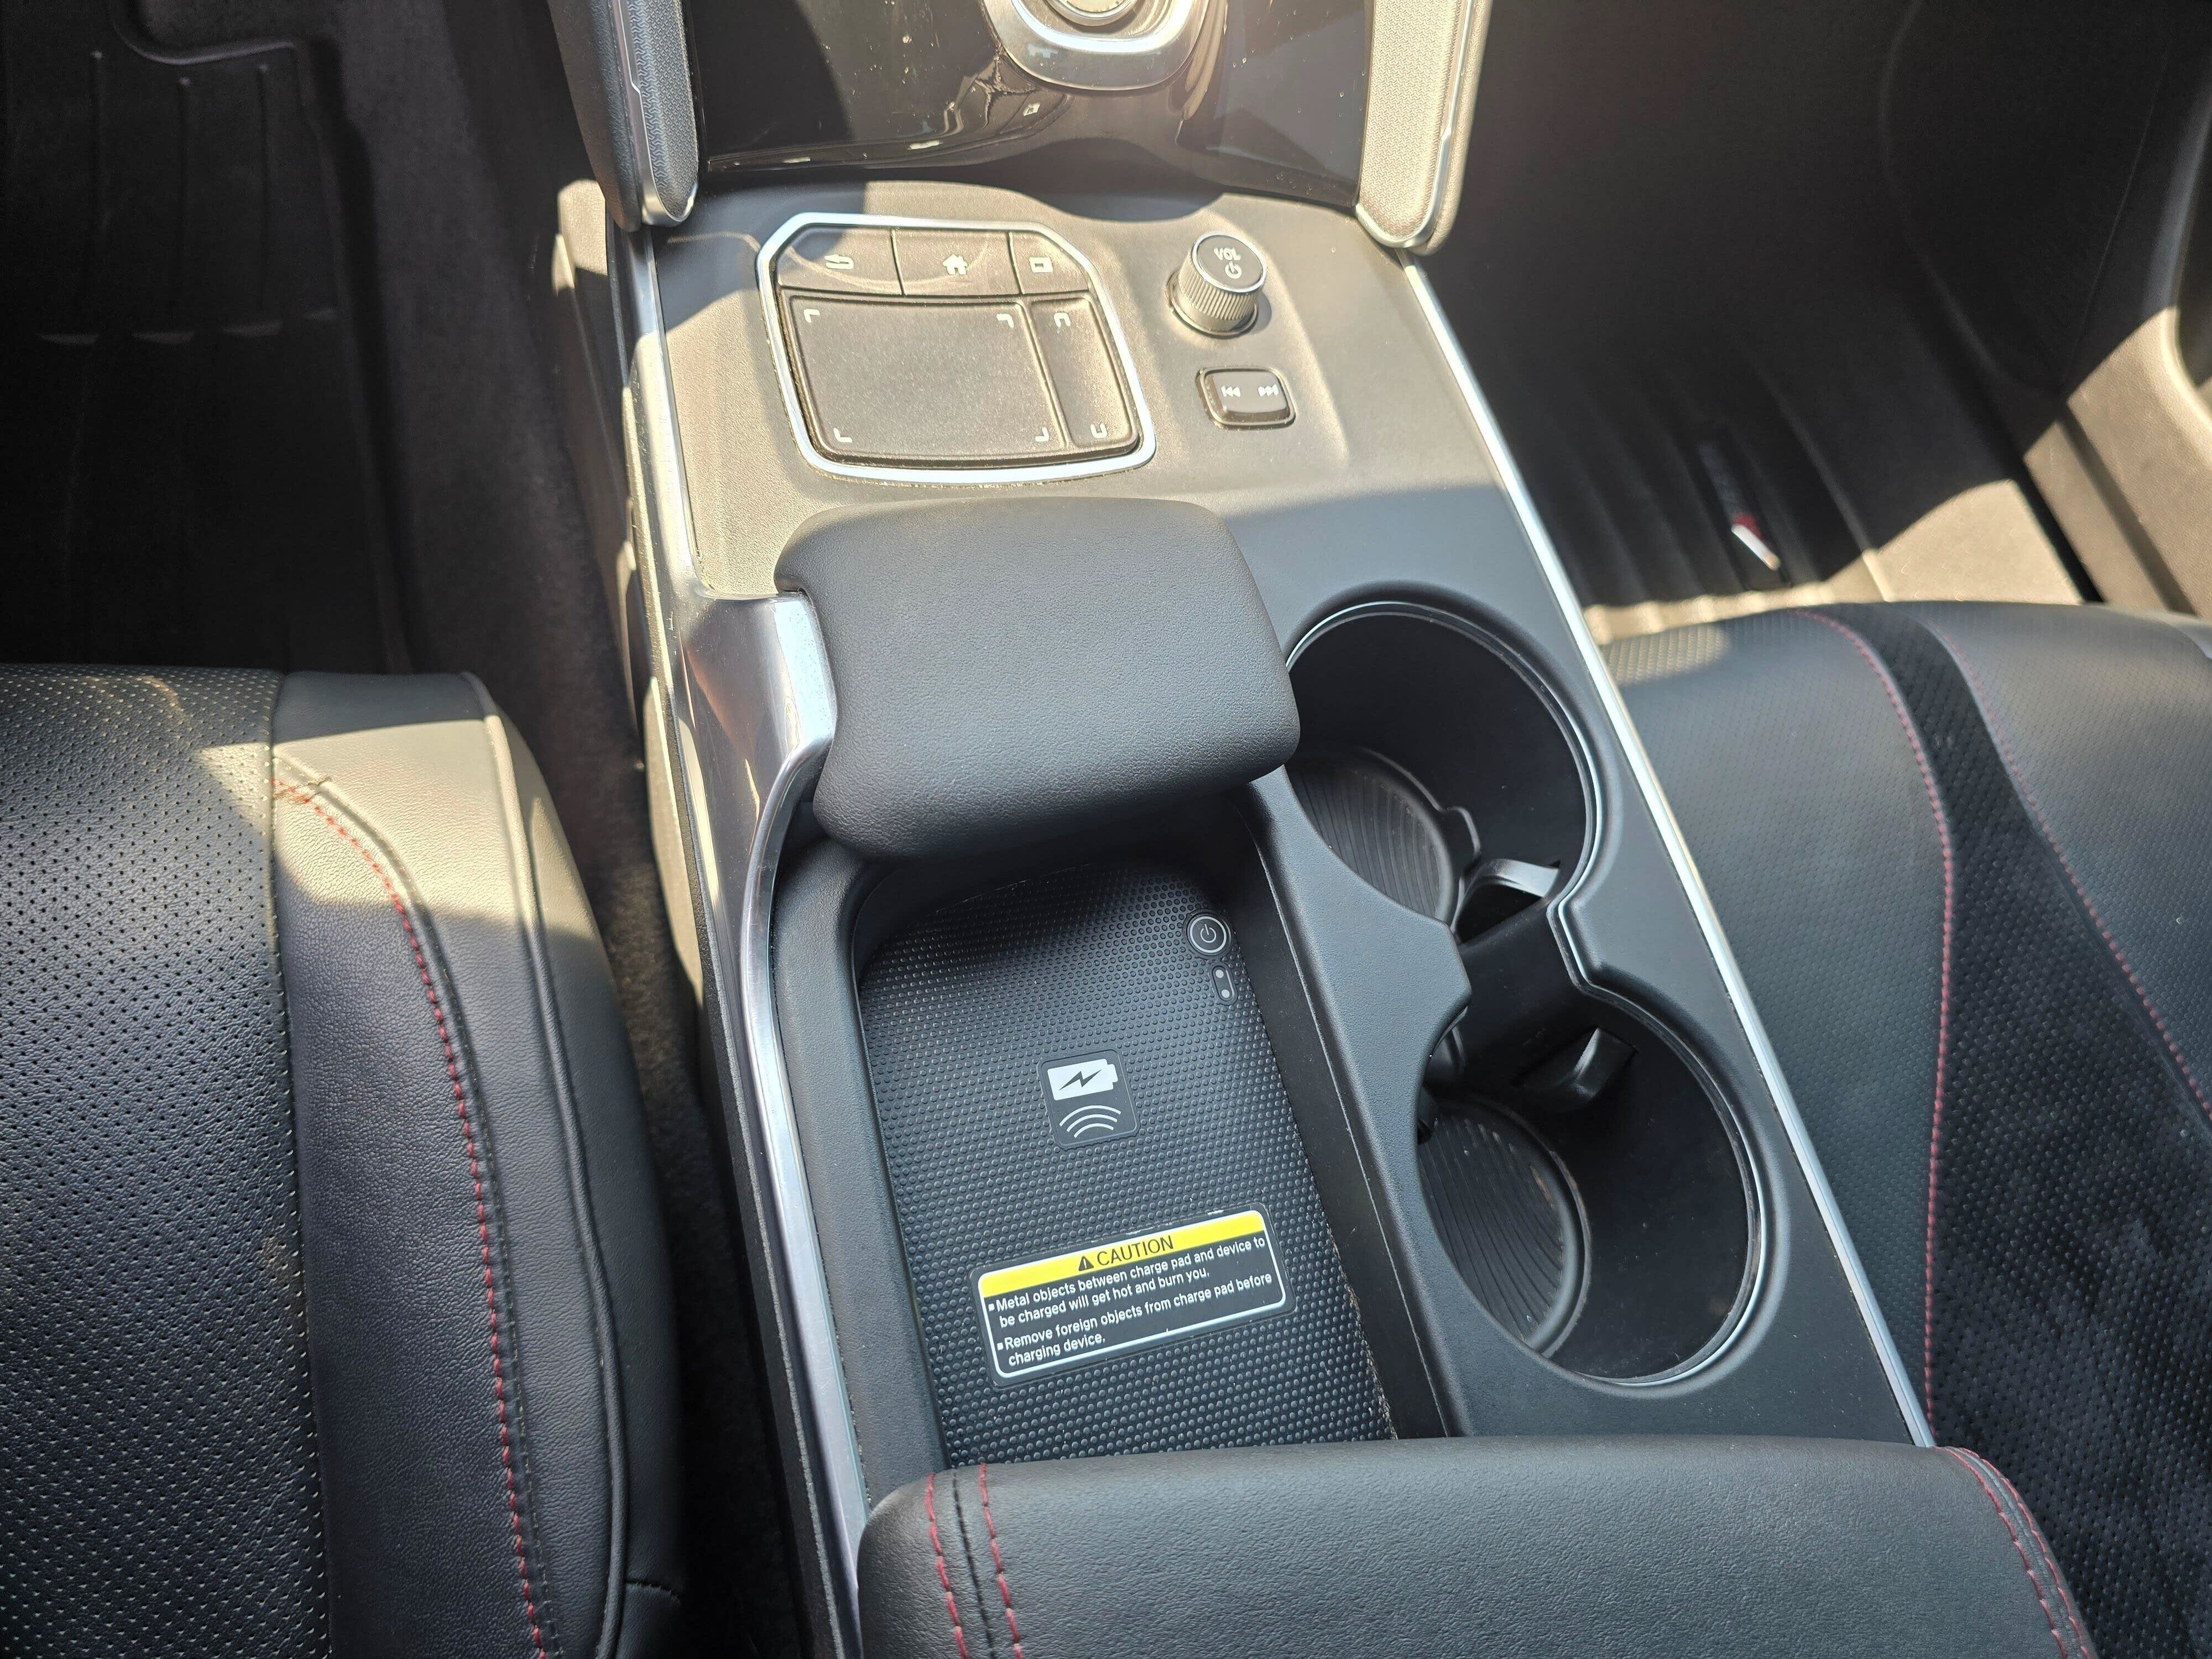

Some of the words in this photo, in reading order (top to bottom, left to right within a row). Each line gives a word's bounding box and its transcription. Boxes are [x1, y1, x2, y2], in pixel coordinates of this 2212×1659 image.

[1213, 247, 1241, 260] VOL
[1097, 1235, 1173, 1266] CAUTION
[996, 1292, 1030, 1312] Metal
[1033, 1282, 1076, 1302] objects
[1078, 1271, 1127, 1292] between
[1130, 1259, 1168, 1279] charge
[1171, 1253, 1191, 1268] pad
[1194, 1248, 1214, 1262] and
[1216, 1239, 1252, 1258] device
[1253, 1236, 1265, 1248] to
[1000, 1316, 1015, 1327] be
[1018, 1300, 1066, 1322] charged
[1069, 1294, 1089, 1311] will
[1092, 1289, 1110, 1306] get
[1113, 1284, 1133, 1298] hot
[1135, 1280, 1156, 1294] and
[1158, 1273, 1184, 1288] burn
[1186, 1267, 1209, 1282] you.
[1005, 1329, 1053, 1350] Remove
[1056, 1317, 1098, 1337] foreign
[1100, 1305, 1142, 1324] objects
[1145, 1298, 1172, 1314] from
[1174, 1287, 1212, 1306] charge
[1214, 1281, 1234, 1297] pad
[1237, 1273, 1272, 1291] before
[1009, 1343, 1061, 1366] charging
[1063, 1333, 1105, 1352] device.
